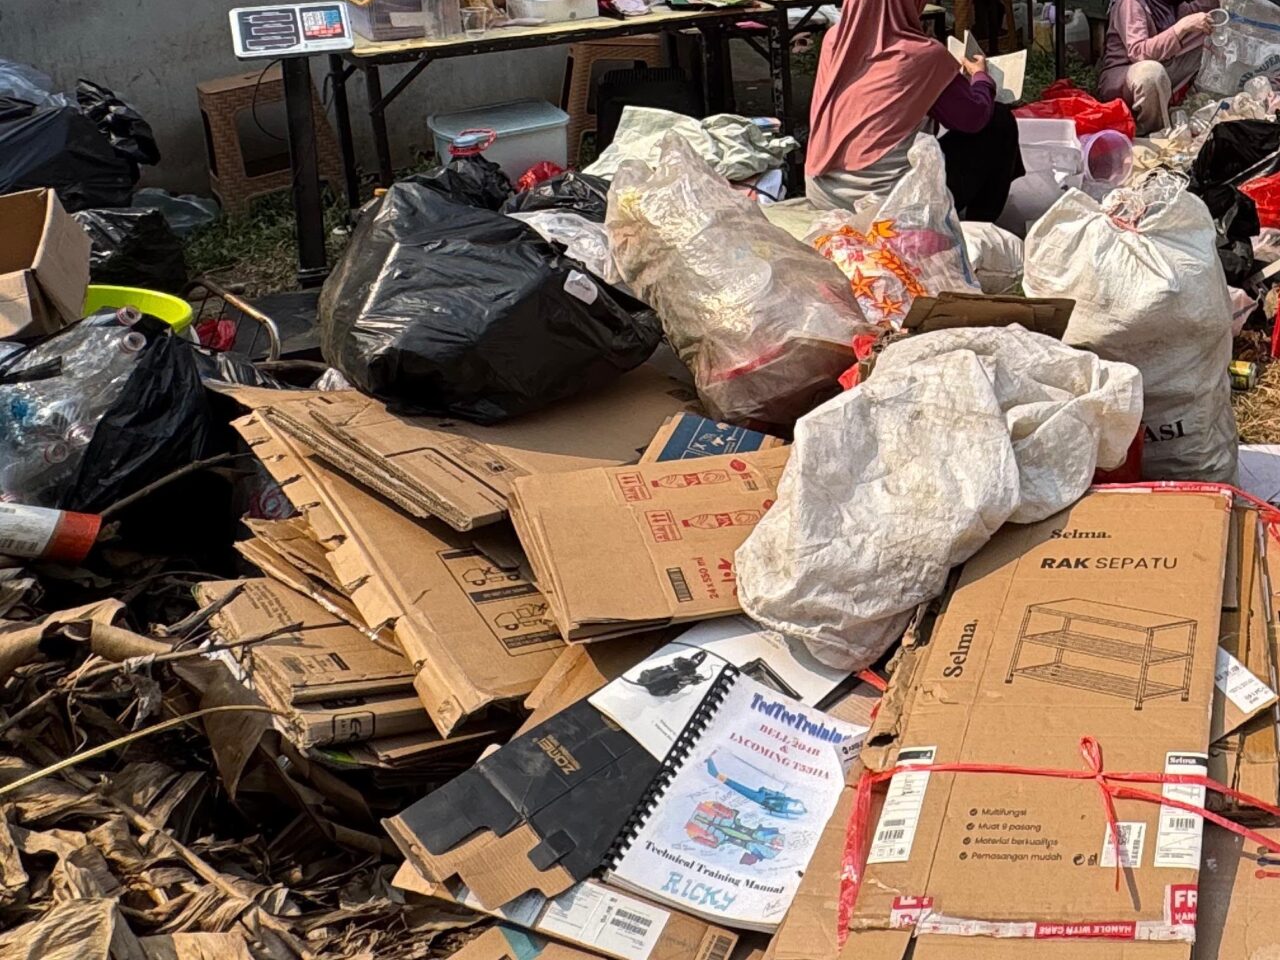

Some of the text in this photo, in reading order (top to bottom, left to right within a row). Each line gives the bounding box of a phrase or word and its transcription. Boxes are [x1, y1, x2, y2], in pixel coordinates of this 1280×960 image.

[1050, 528, 1112, 540] Selma.
[1040, 557, 1178, 570] RAK SEPATU
[729, 732, 792, 768] LYCOMING
[981, 808, 1027, 818] Multifungsi
[978, 823, 1000, 831] Muat
[1008, 824, 1042, 832] pasang
[974, 837, 1010, 845] Material
[971, 852, 1063, 862] Pemasangan mudah
[645, 840, 785, 894] Technical Training Manual
[1038, 924, 1133, 936] HANDLE WITH CARE
